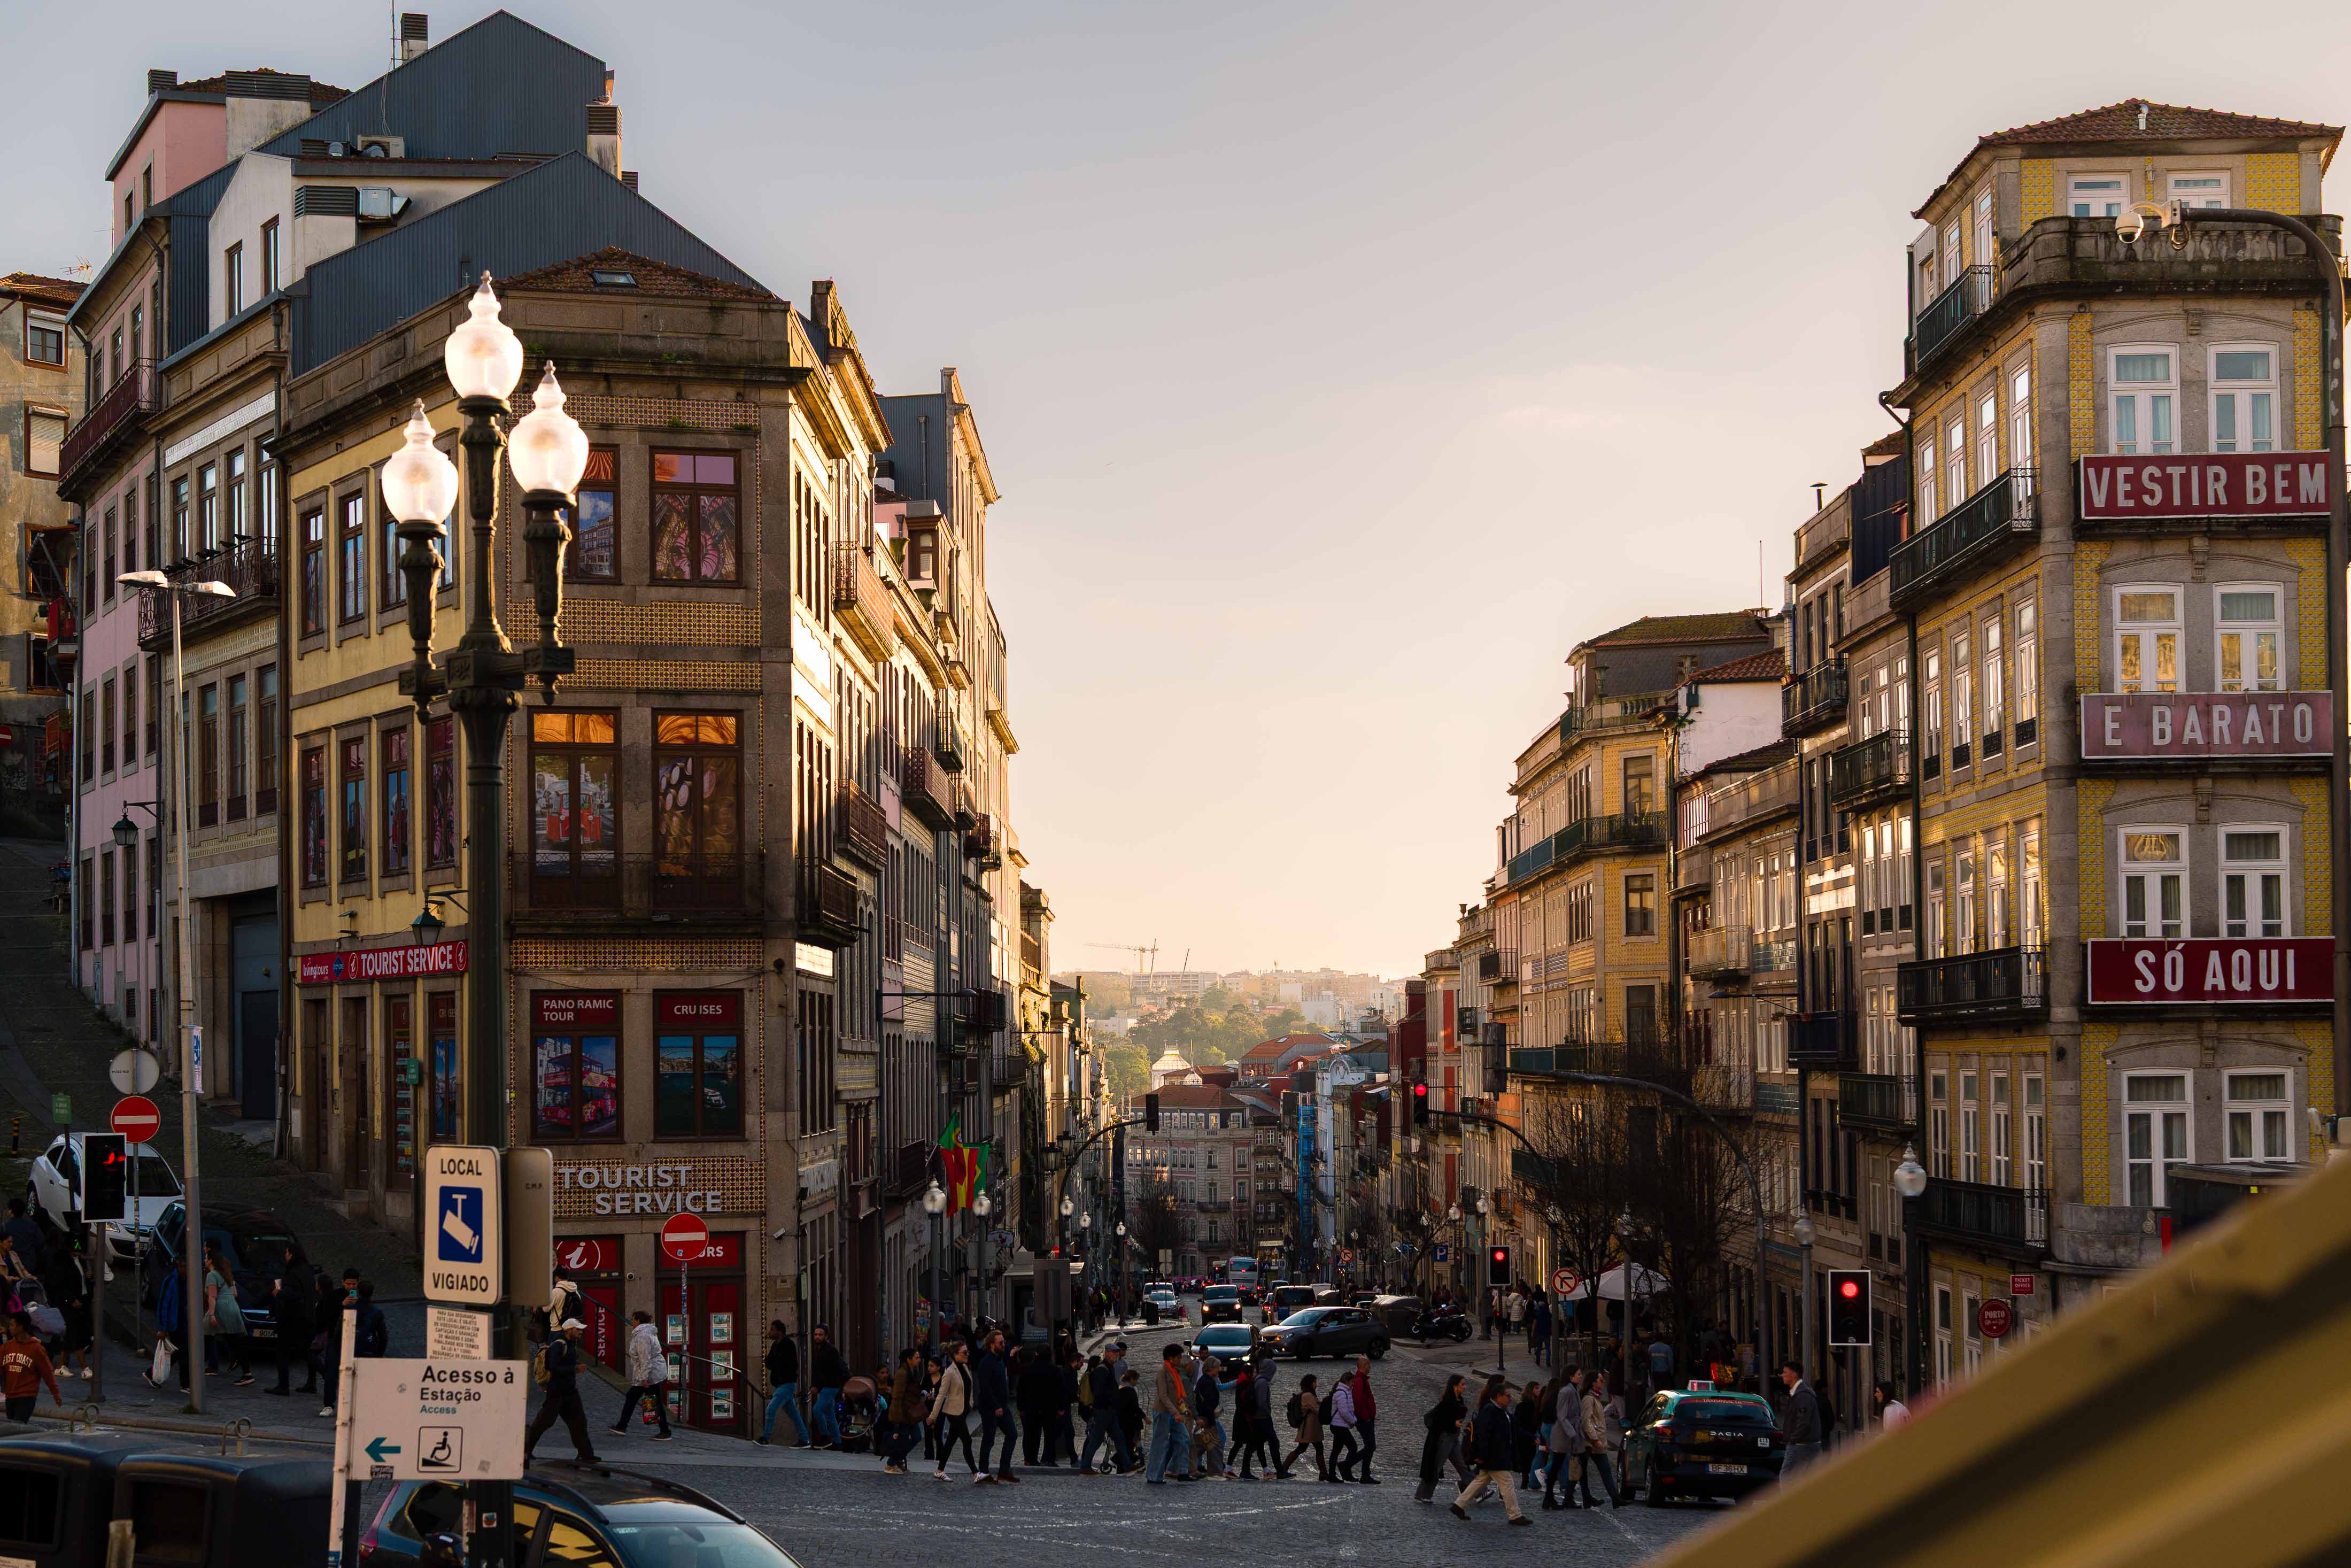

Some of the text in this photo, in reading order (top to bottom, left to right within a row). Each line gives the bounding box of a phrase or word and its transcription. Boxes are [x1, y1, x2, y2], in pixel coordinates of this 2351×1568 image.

[2087, 463, 2325, 507] VESTIR BEM
[2105, 702, 2313, 746] E BARATO
[361, 945, 453, 976] TOURIST SERVICE
[2134, 943, 2295, 992] SÓ AQUI
[543, 1011, 574, 1022] TOUR
[440, 1158, 482, 1176] LOCAL
[559, 1165, 692, 1189] TOURIST
[595, 1191, 722, 1215] SERVICE
[432, 1272, 489, 1292] VIGIADO
[1984, 1310, 2005, 1318] PORTO
[598, 1307, 606, 1356] SERVICE
[16, 1353, 33, 1368] COAST
[422, 1365, 514, 1384] Acesso à
[420, 1388, 481, 1404] Estação
[420, 1405, 457, 1415] Access
